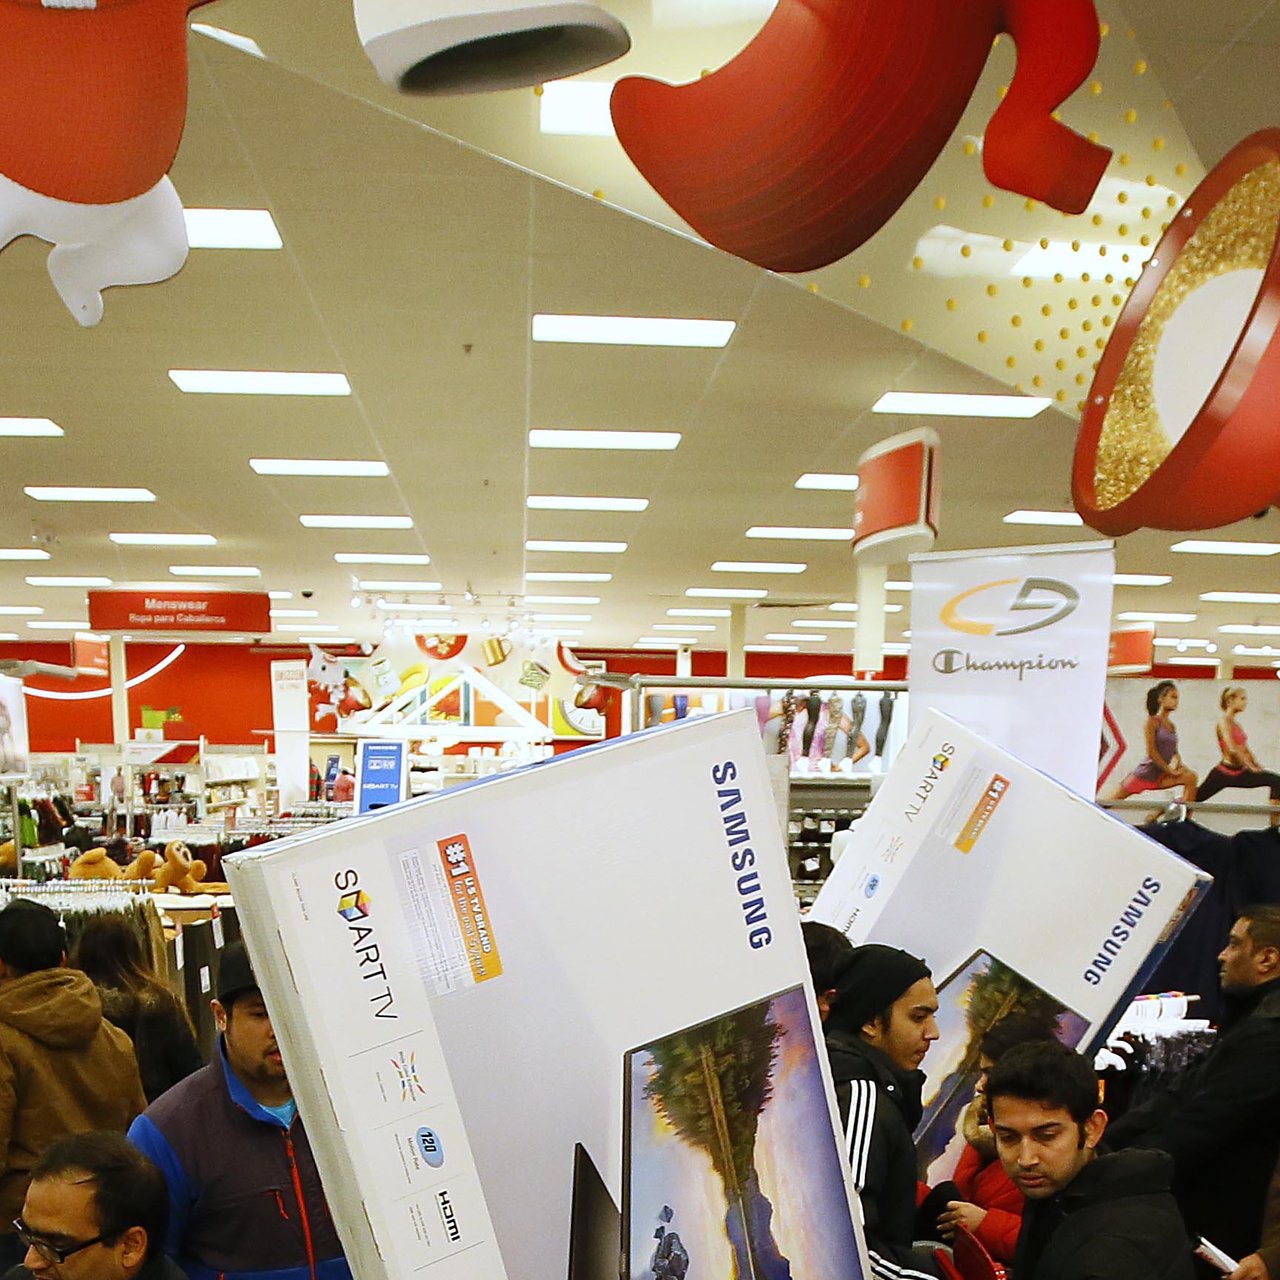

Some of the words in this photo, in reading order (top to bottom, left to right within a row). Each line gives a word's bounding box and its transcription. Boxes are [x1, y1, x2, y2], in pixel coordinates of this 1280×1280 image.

[145, 598, 208, 610] Menswear
[154, 614, 174, 625] para
[932, 649, 1079, 681] Champion
[444, 842, 471, 877] #1
[712, 761, 774, 952] SAMSUNG
[334, 869, 387, 982] SMART
[370, 985, 399, 1020] TV
[473, 912, 492, 954] BRAND
[1084, 877, 1161, 986] SAMSUNG
[419, 1130, 437, 1153] 120
[436, 1190, 461, 1243] HDMI
